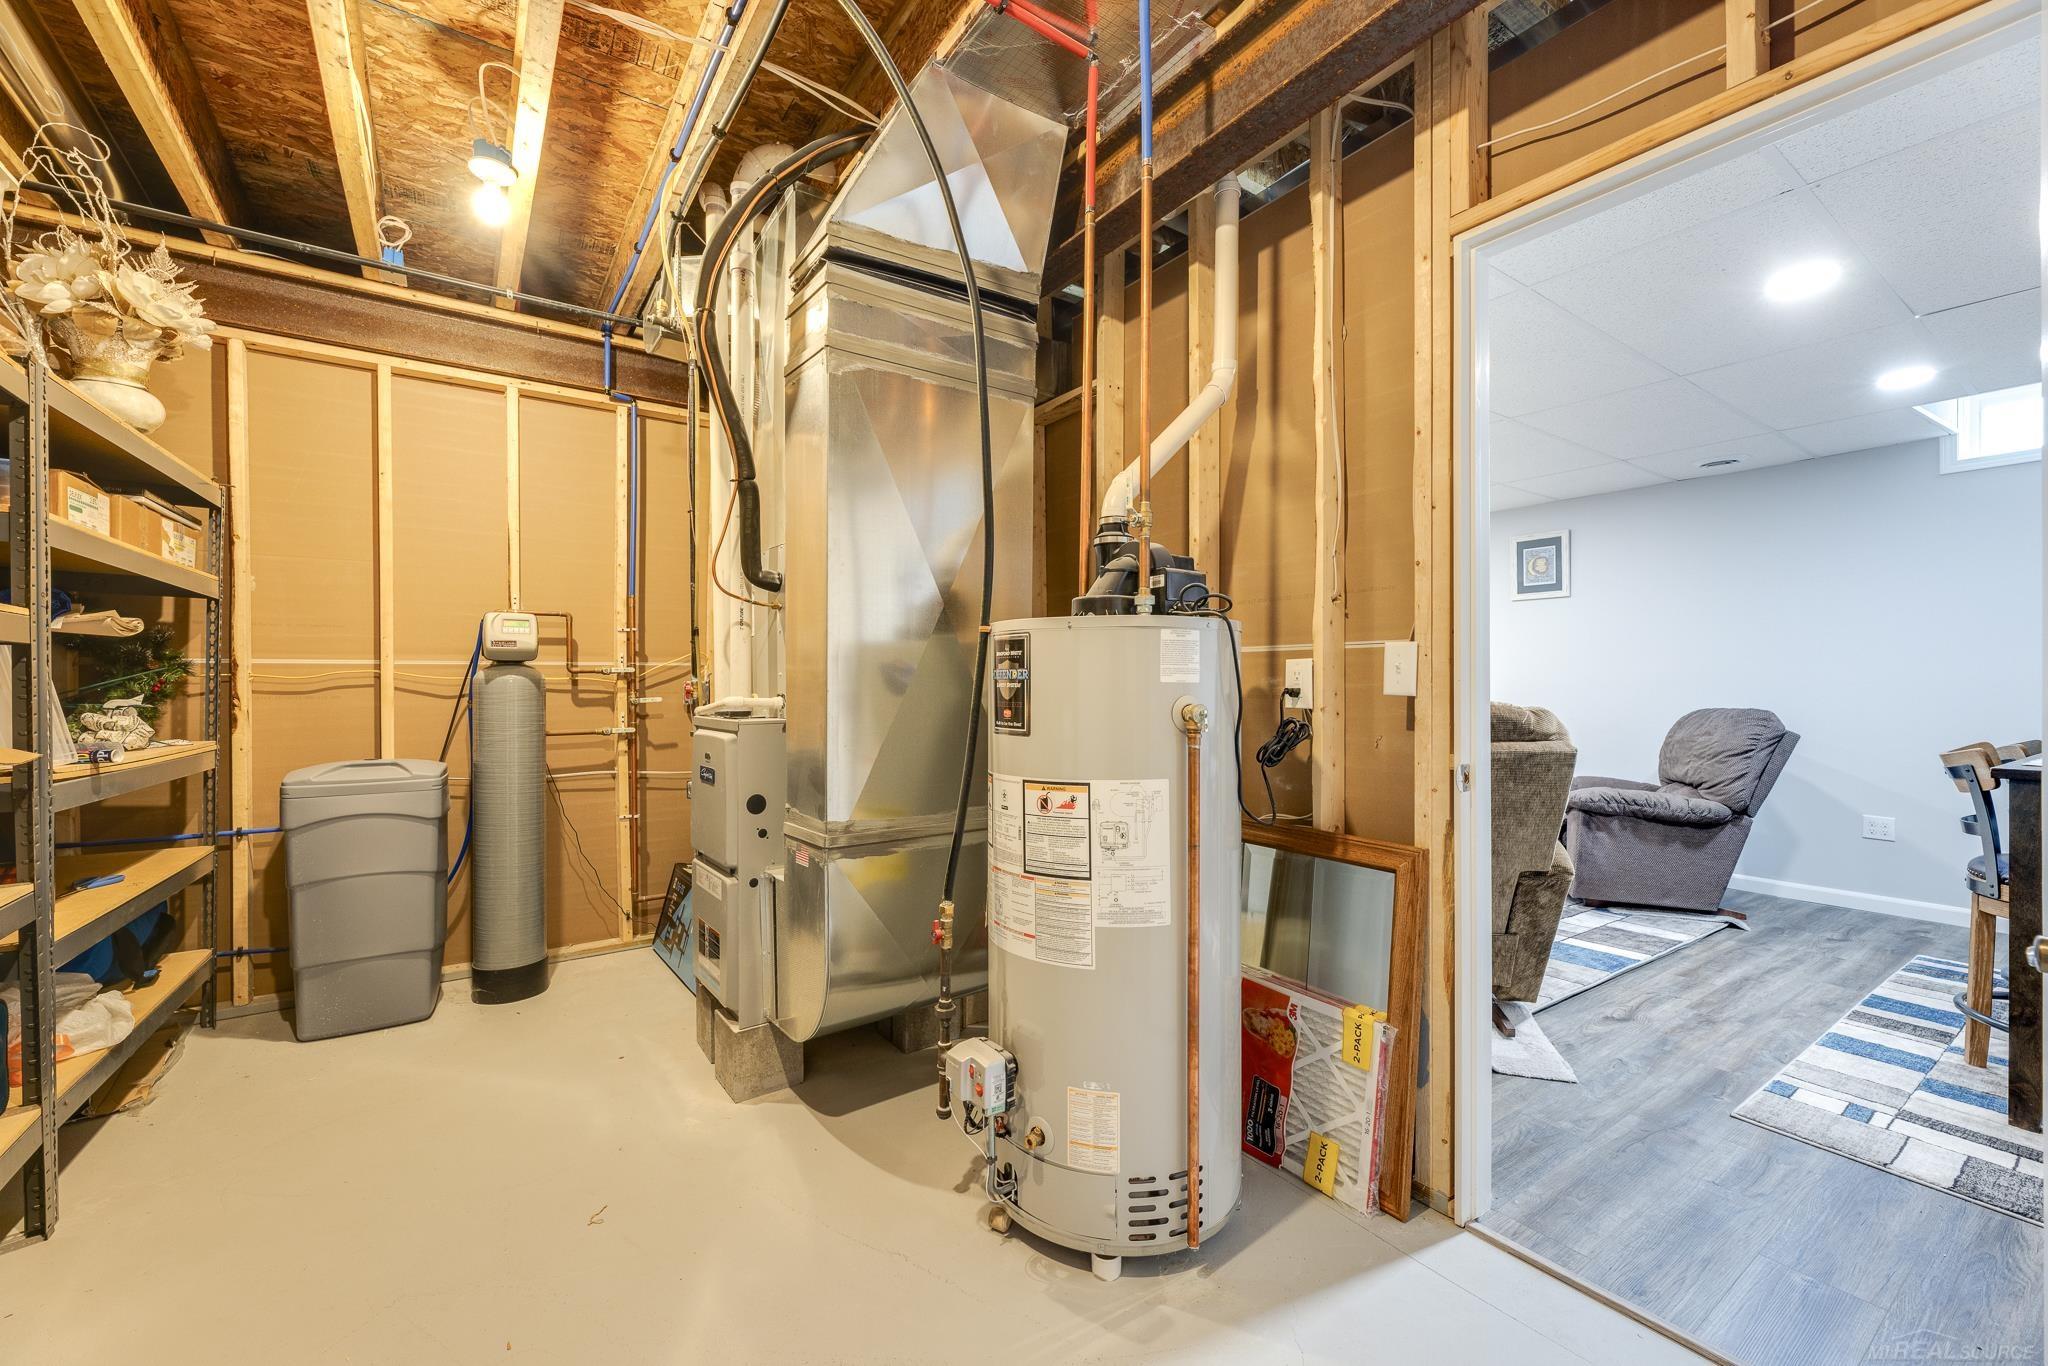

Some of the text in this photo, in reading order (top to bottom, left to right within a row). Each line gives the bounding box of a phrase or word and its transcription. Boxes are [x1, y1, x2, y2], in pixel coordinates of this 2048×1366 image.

[1289, 1002, 1298, 1021] 3M
[1353, 1022, 1362, 1064] 2-PACK
[1246, 1119, 1254, 1141] 1000
[1314, 1141, 1328, 1183] 2-PACK
